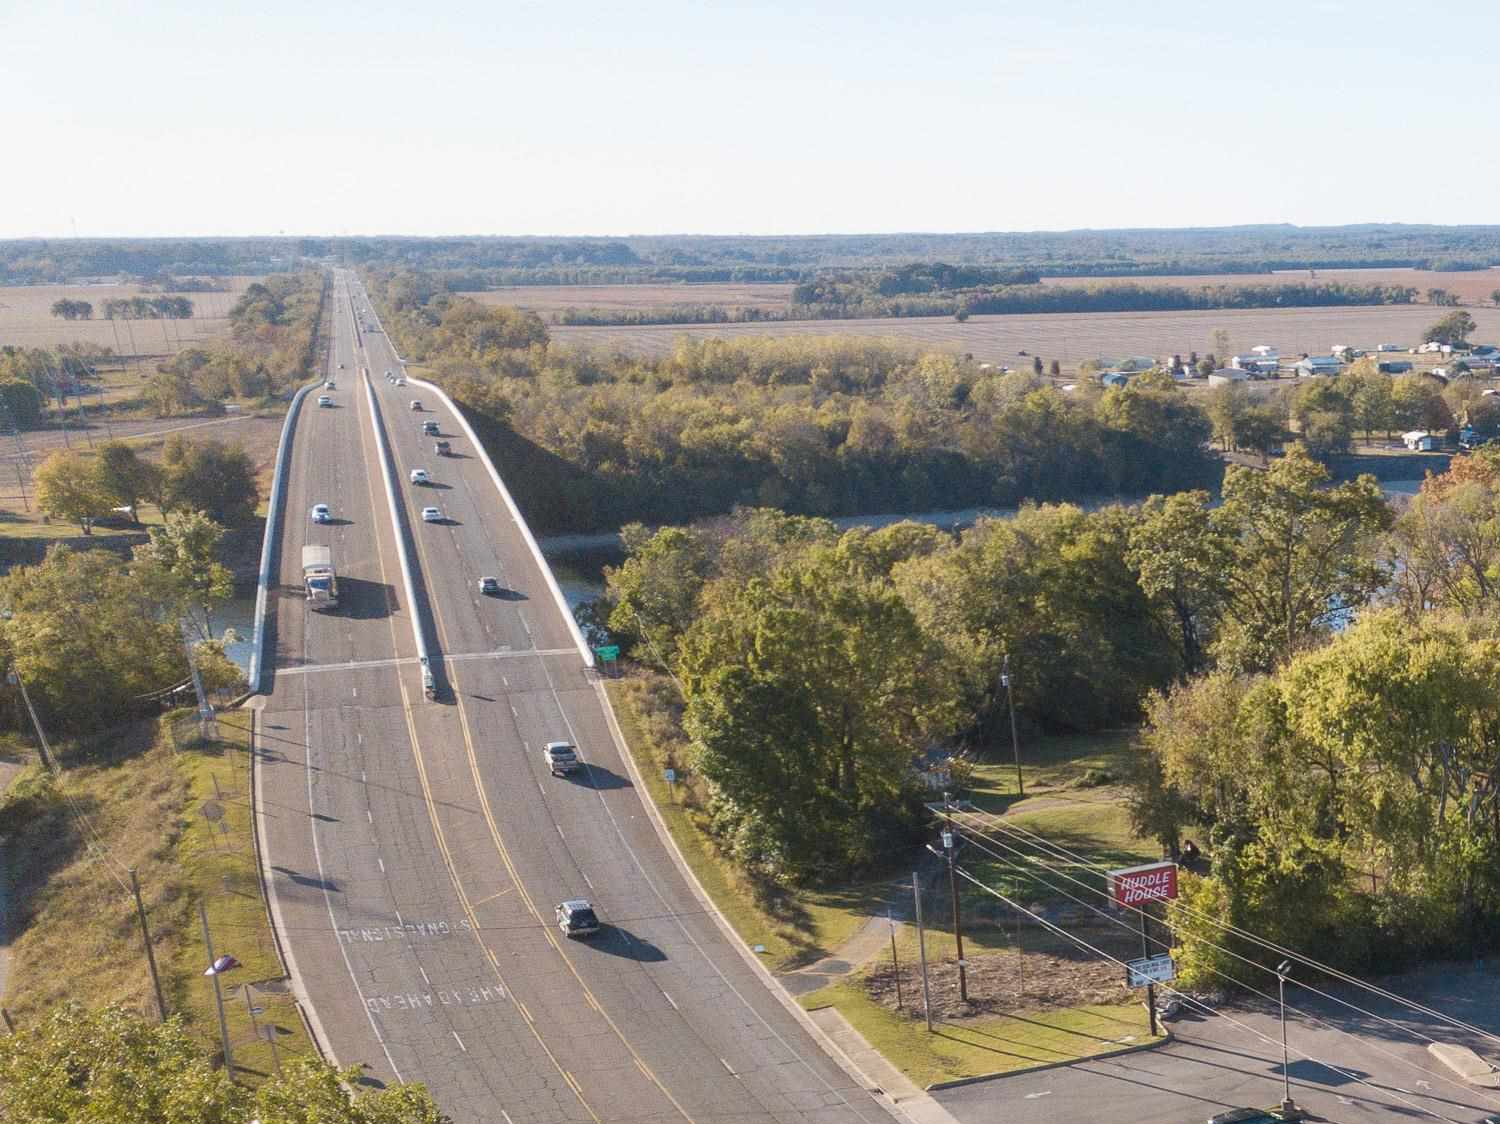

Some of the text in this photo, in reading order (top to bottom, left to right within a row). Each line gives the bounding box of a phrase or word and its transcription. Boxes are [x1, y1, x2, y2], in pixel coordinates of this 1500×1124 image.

[1121, 871, 1171, 891] HUDDLE
[1125, 885, 1169, 903] HOUSE
[406, 919, 471, 937] SGNAL
